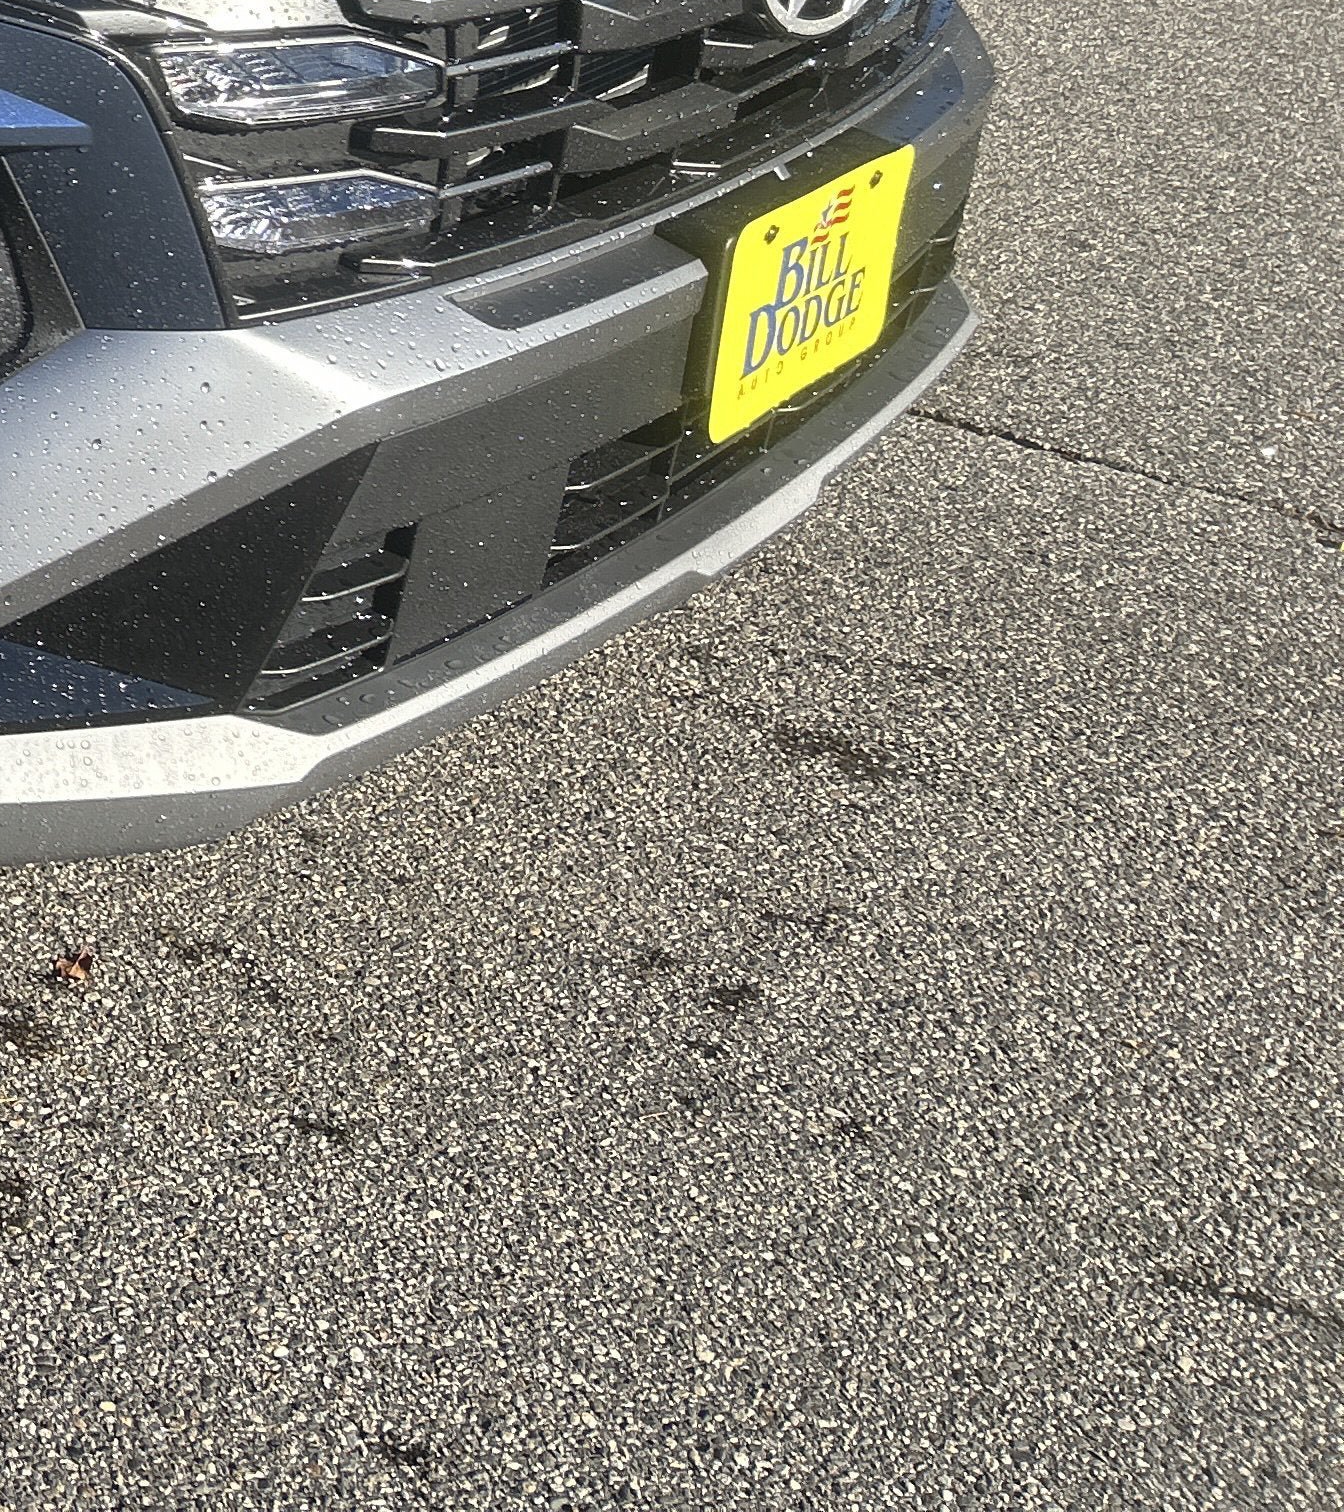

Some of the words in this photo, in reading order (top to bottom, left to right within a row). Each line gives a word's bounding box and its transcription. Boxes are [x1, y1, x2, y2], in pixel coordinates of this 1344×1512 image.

[774, 231, 853, 310] BILL
[737, 361, 784, 400] AUTO
[800, 316, 857, 360] GROUP
[739, 266, 866, 381] DODGE
